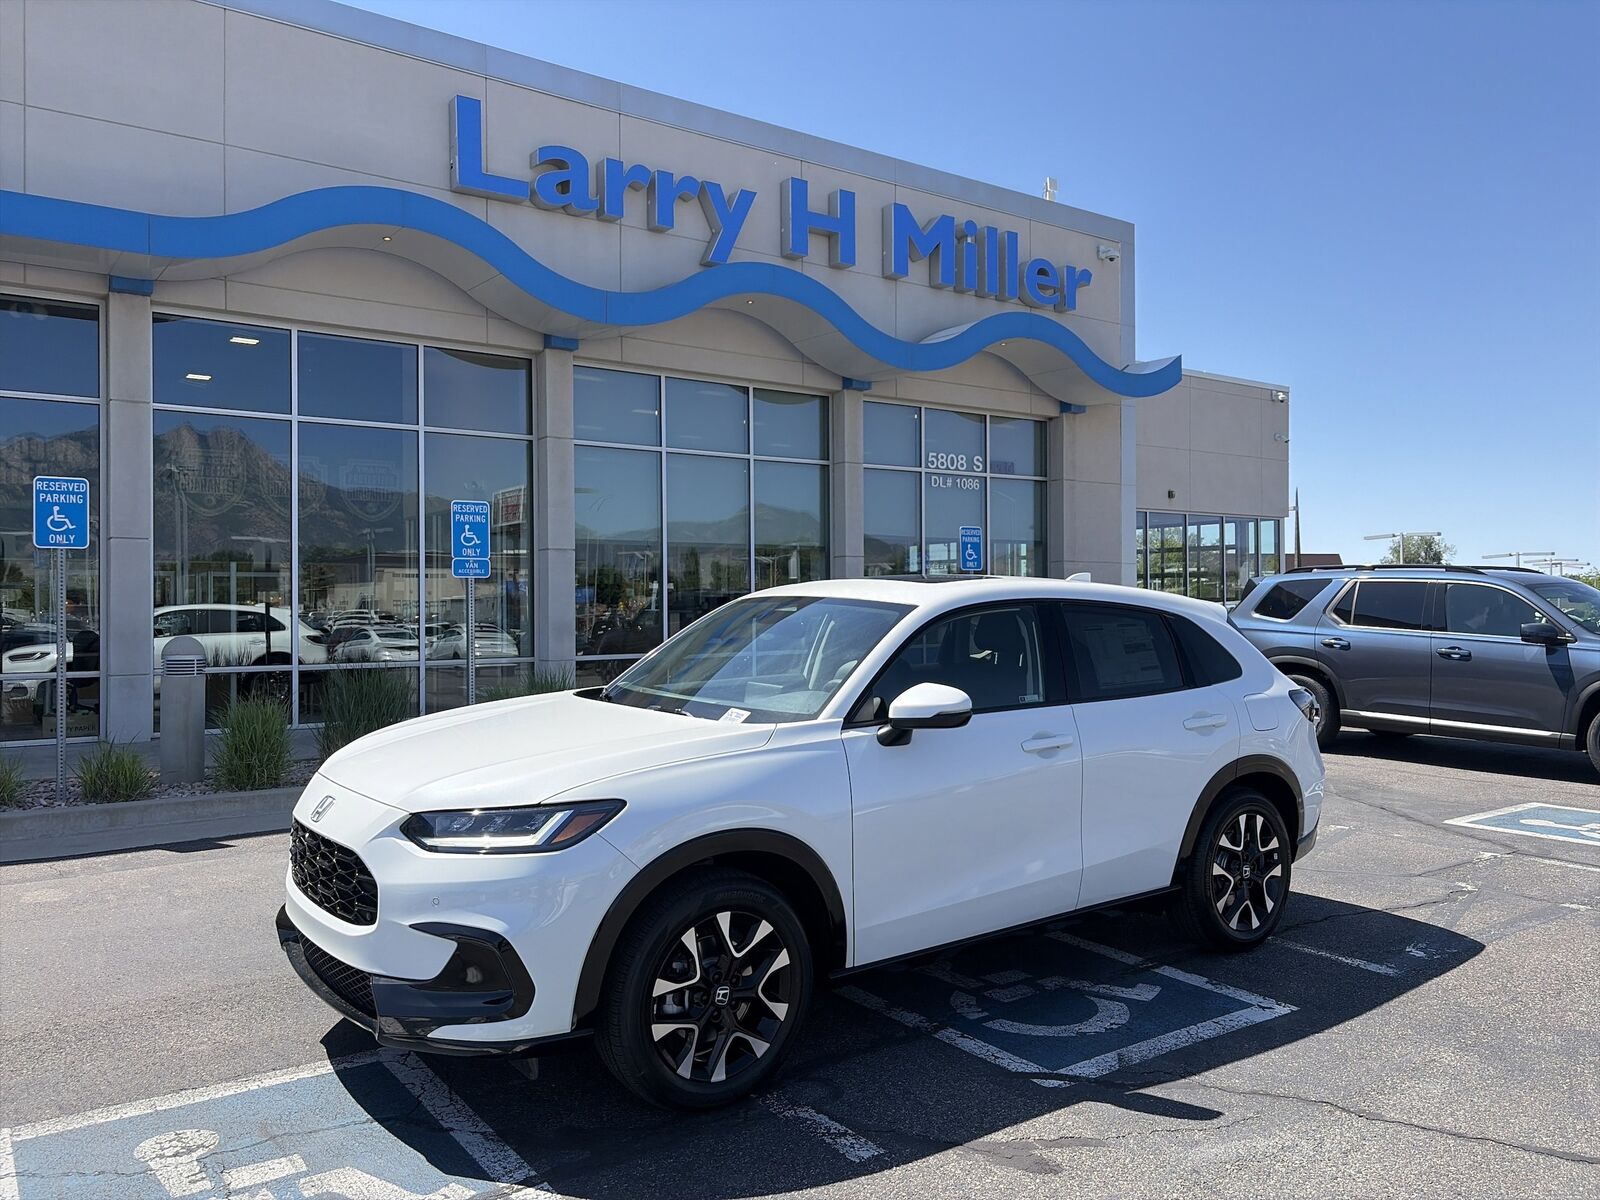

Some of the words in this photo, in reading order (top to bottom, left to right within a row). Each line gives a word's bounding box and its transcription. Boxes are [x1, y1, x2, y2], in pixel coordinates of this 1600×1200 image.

[452, 95, 757, 266] Larry
[783, 177, 856, 267] H
[883, 202, 1093, 312] Miller
[928, 452, 966, 470] 5808
[973, 456, 983, 471] S
[36, 481, 86, 492] RESERVED
[931, 475, 952, 488] DL#
[956, 478, 979, 490] 1086
[40, 493, 83, 503] PARKING
[453, 504, 487, 512] RESERVED
[455, 514, 485, 522] PARKING
[49, 534, 75, 543] ONLY
[462, 548, 480, 556] ONLY
